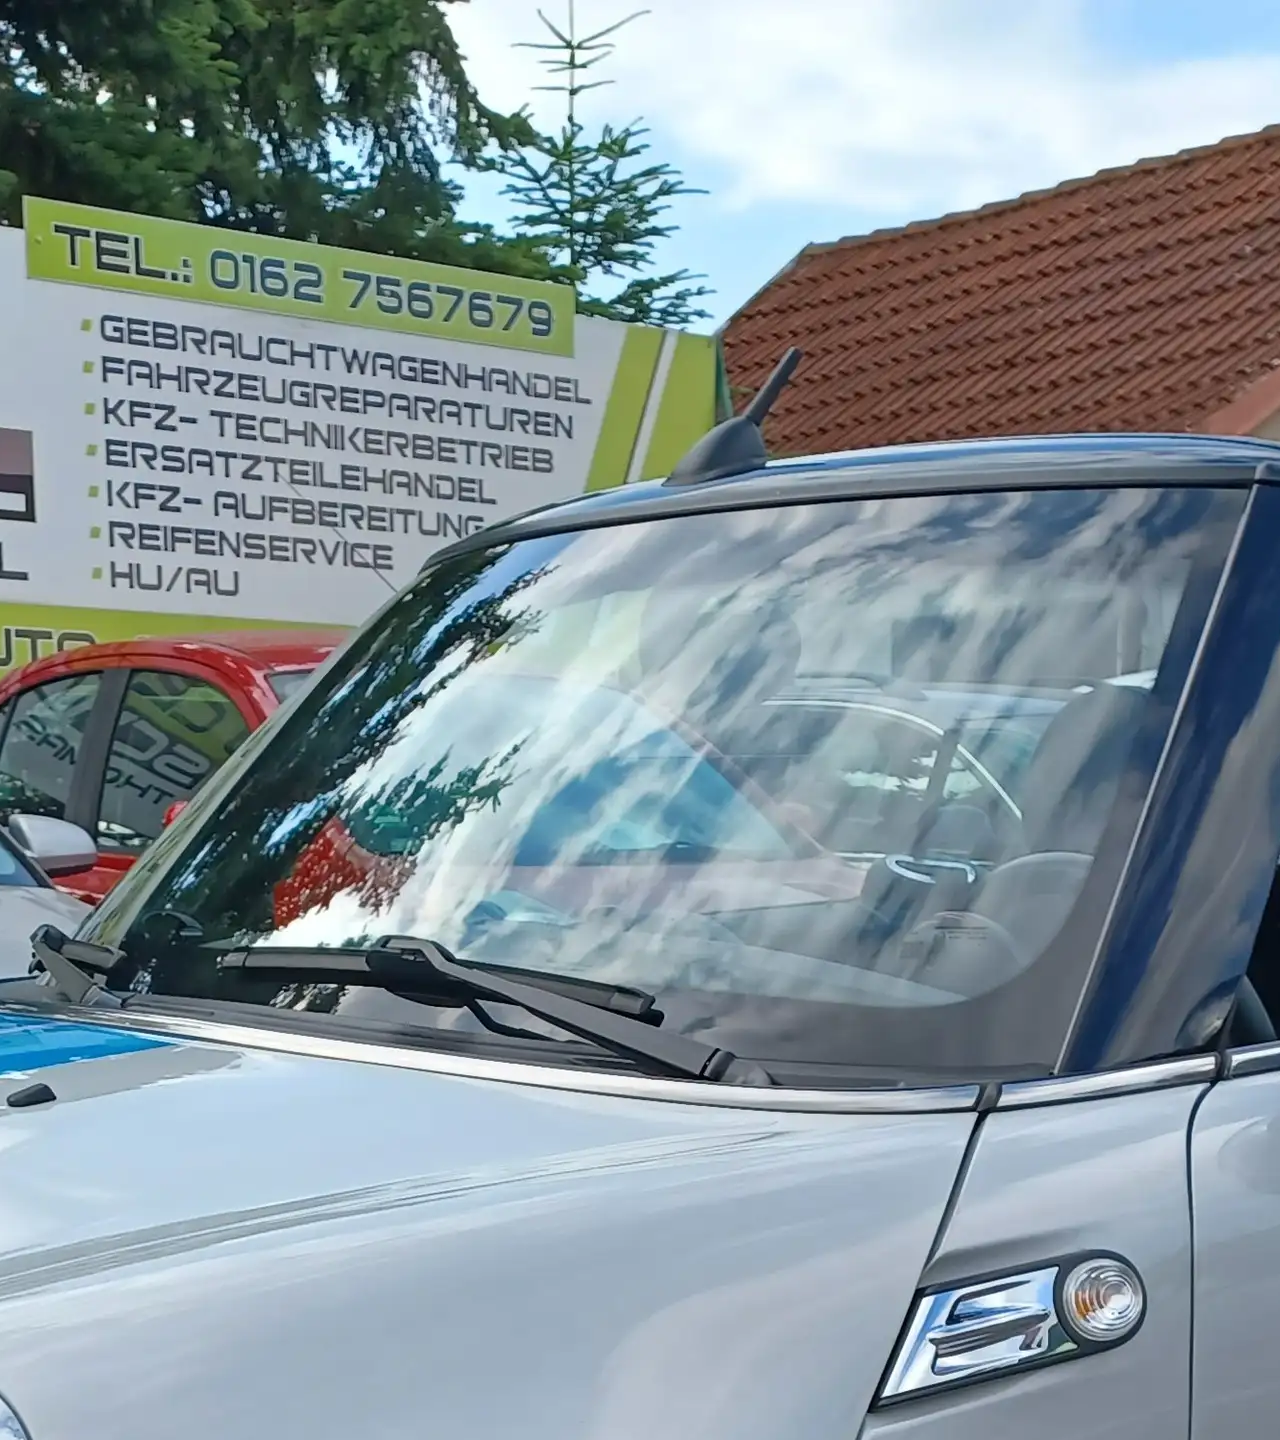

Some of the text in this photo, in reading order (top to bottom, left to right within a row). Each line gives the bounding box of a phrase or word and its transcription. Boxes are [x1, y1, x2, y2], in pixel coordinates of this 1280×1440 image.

[54, 224, 554, 337] TEL.: 0162 7567679
[101, 315, 591, 403] GEBRAUCHTWAGENHANDEL
[102, 356, 573, 438] FAHRZEUGREPARATUREN
[104, 397, 554, 473] KFZ- TECHNIKERBETRIEB
[105, 439, 497, 504] ERSATZTEILEHANDEL
[107, 480, 485, 539] KFZ- AUFBEREITUNG
[109, 521, 394, 570] REIFENSERVICE
[110, 561, 239, 596] HU/AU
